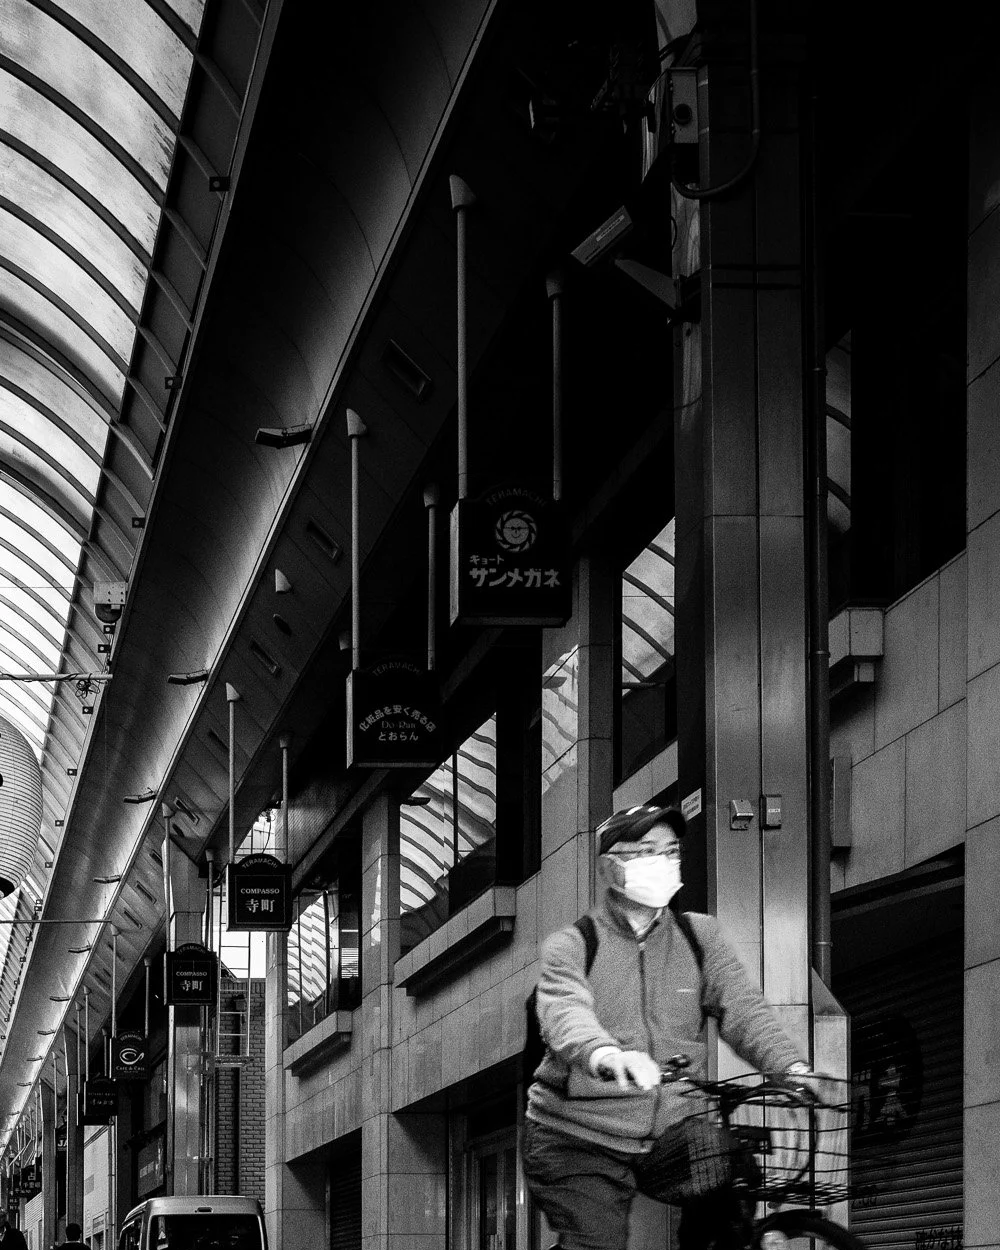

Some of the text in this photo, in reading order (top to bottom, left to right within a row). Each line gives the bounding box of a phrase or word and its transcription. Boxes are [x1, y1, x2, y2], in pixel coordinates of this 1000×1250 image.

[469, 554, 505, 566] キョート
[469, 568, 562, 588] サンメガネ
[359, 704, 437, 733] 化粧品を安く売る店
[241, 856, 279, 869] TERAMACHI
[240, 887, 280, 895] COMPASSO
[245, 899, 276, 913] 寺町
[179, 980, 204, 992] 寺町
